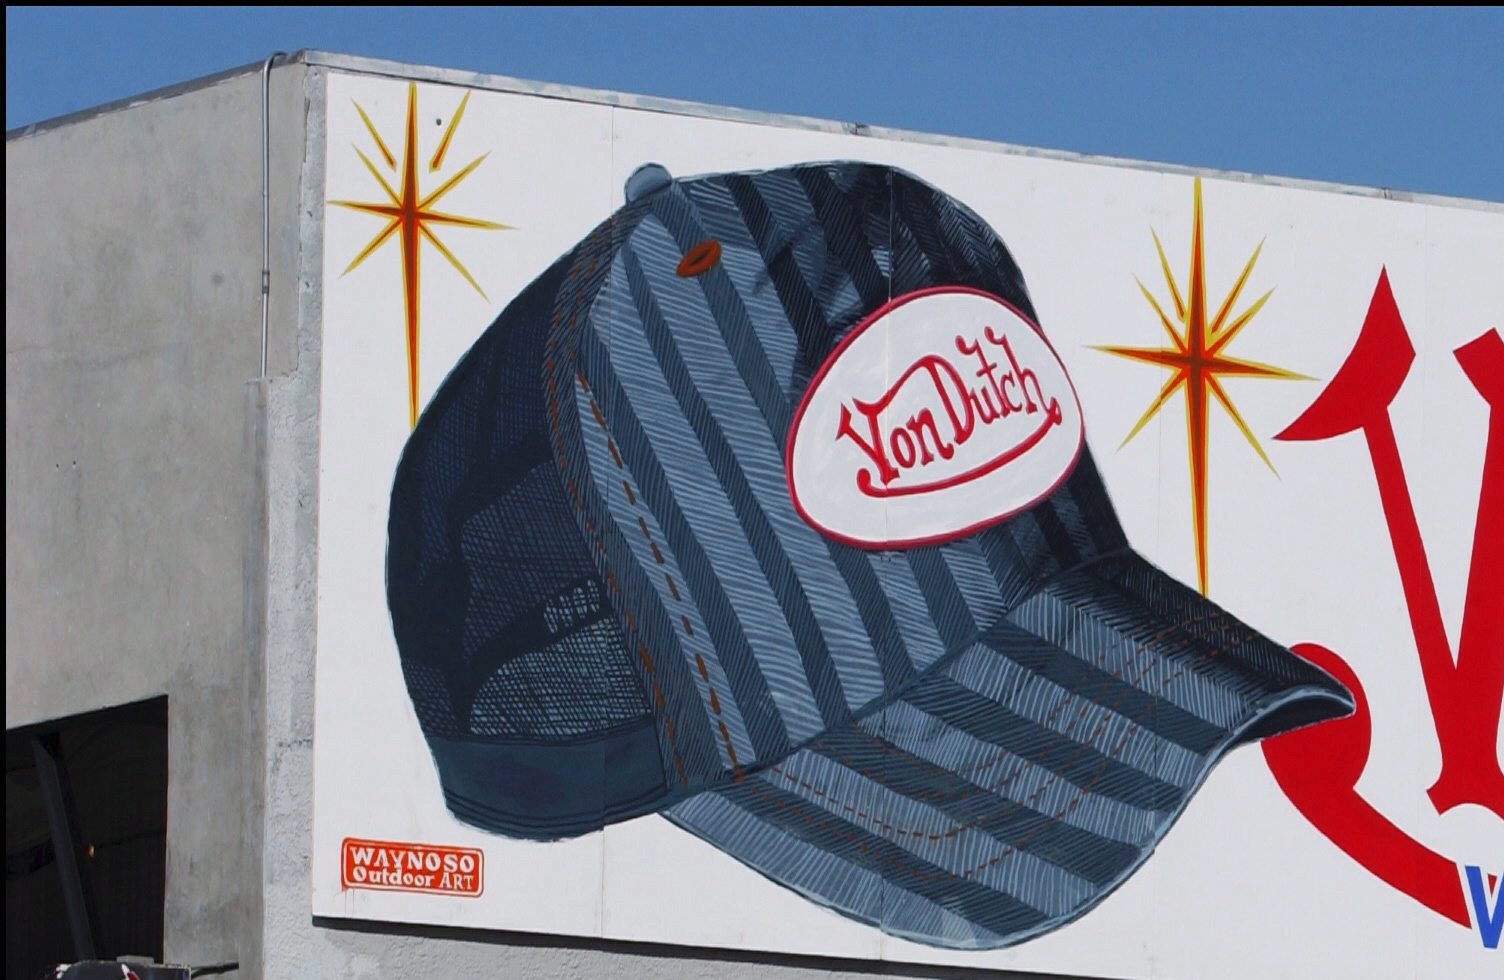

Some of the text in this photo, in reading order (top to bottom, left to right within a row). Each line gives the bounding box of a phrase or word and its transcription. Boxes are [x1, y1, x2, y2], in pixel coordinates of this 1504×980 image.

[835, 325, 1063, 487] Von Dutch
[349, 846, 475, 873] WAYNOSO
[352, 865, 474, 890] Outdoor ART
